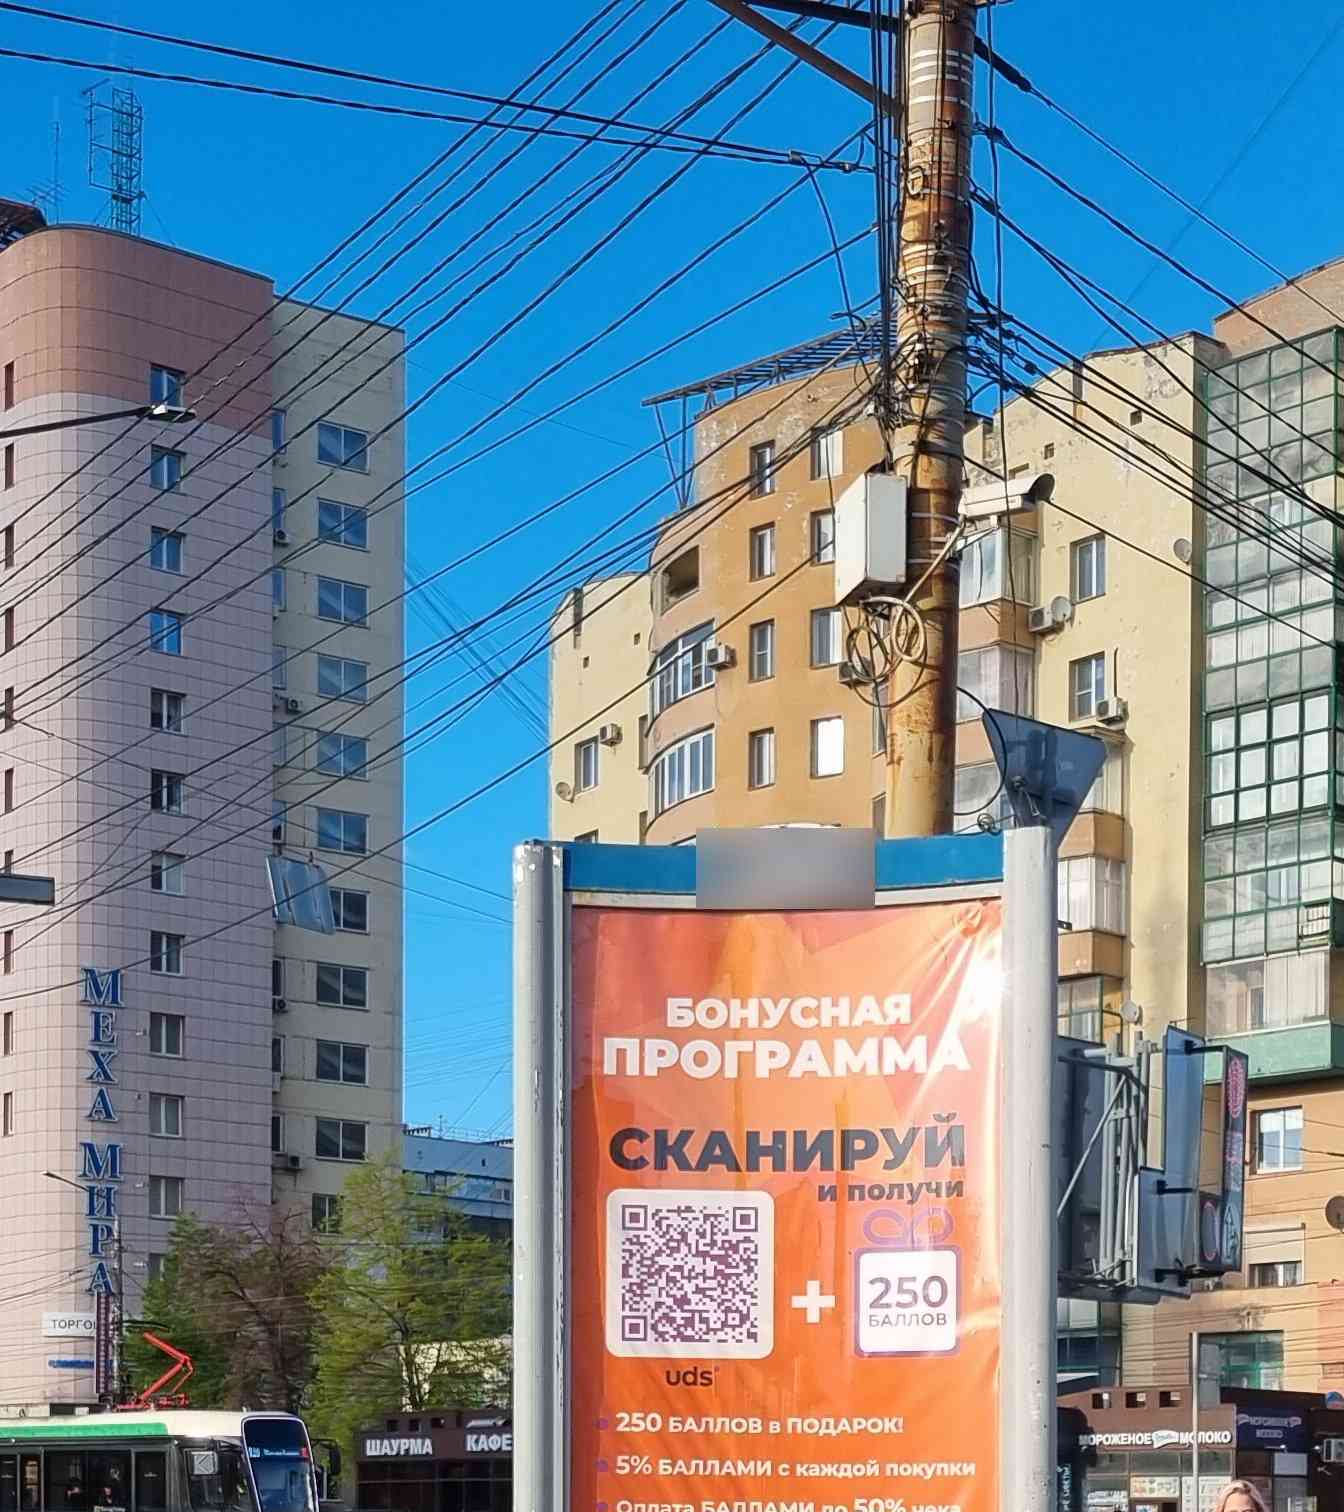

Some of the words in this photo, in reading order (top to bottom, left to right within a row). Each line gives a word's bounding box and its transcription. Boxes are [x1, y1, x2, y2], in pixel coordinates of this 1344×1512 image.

[666, 993, 912, 1029] БОНУСНАЯ
[80, 968, 124, 1122] МЕХА
[603, 1034, 971, 1079] ПРОГРАММА
[609, 1112, 967, 1173] СКАНИРУЙ
[818, 1184, 837, 1202] и
[848, 1179, 964, 1205] получи
[79, 1142, 122, 1296] МИРА
[868, 1275, 949, 1310] 250
[868, 1311, 948, 1328] БАЛЛОВ
[665, 1367, 713, 1387] uds
[616, 1412, 662, 1433] 250
[669, 1416, 762, 1433] БАЛЛОВ
[769, 1421, 781, 1434] в
[787, 1416, 904, 1437] ПОДАРОК!
[365, 1438, 433, 1456] ШАУРМА
[466, 1434, 513, 1451] КАФЕ
[1079, 1432, 1152, 1446] МОРОЖЕНОЕ
[616, 1456, 652, 1475] 5%
[658, 1459, 771, 1476] БАЛЛАМИ
[778, 1464, 790, 1476] с
[796, 1460, 880, 1478] каждой
[886, 1462, 976, 1480] покупки
